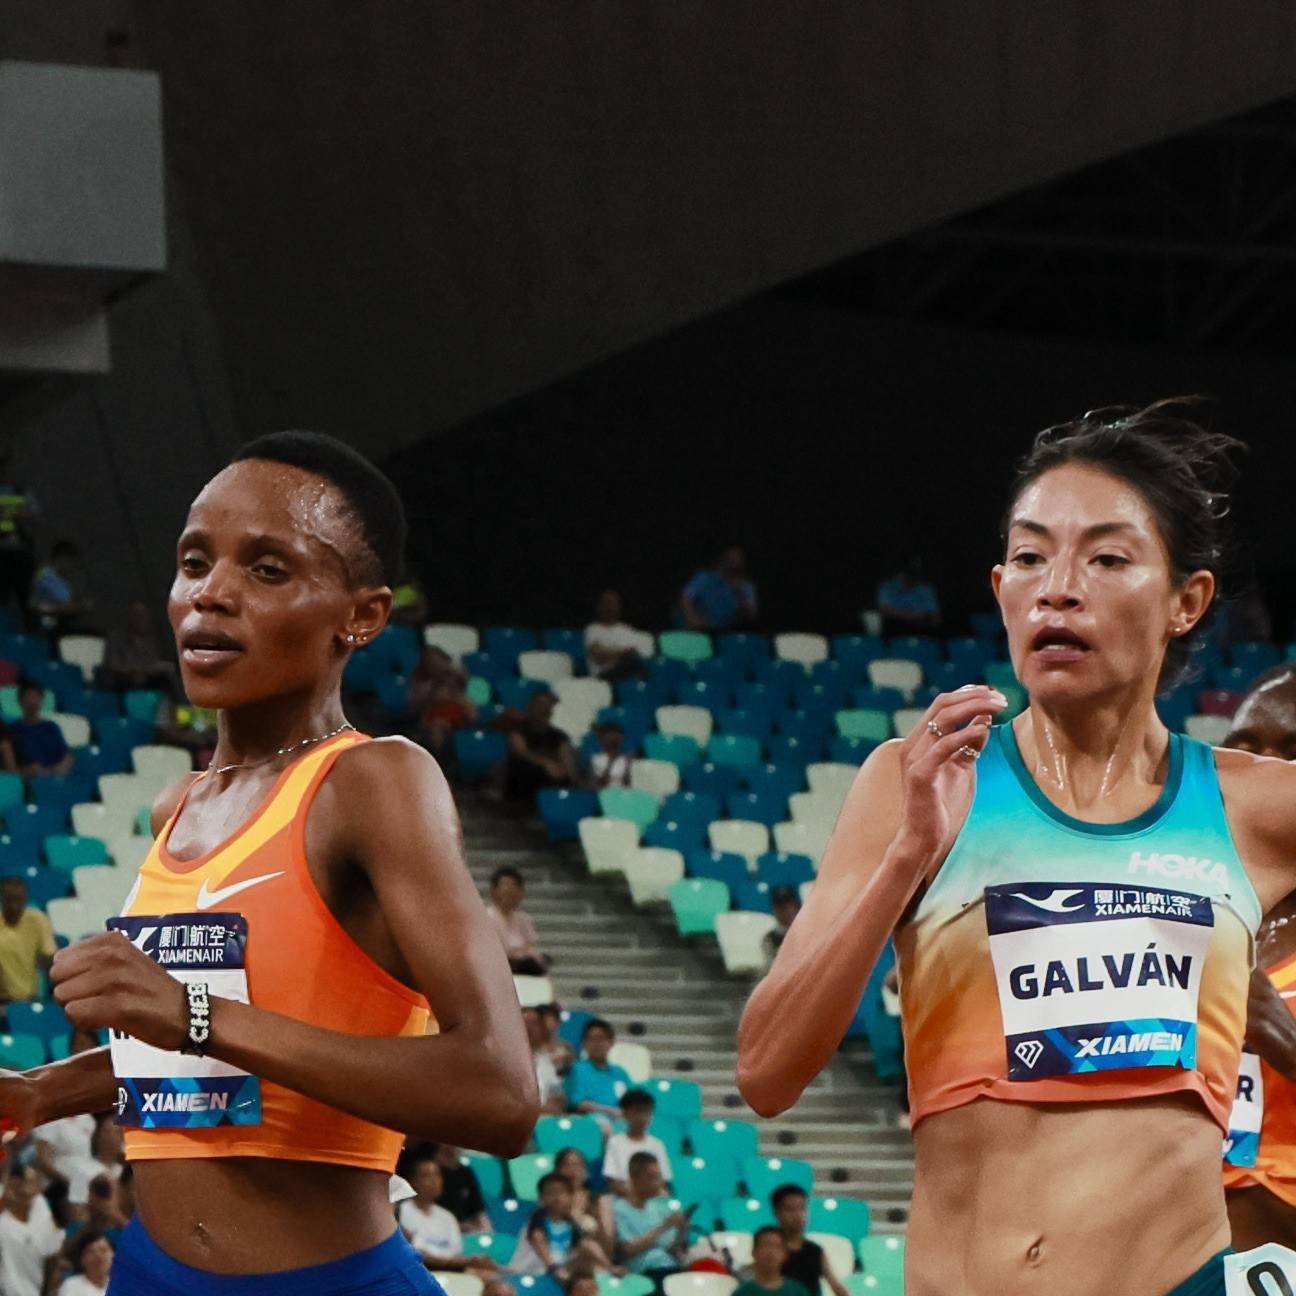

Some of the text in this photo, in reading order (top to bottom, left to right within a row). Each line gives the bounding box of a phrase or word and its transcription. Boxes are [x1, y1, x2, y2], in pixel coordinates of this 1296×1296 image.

[1128, 852, 1232, 888] HOKA
[1094, 889, 1192, 907] 厦门航空
[1095, 903, 1193, 918] XIAMENAIR
[158, 924, 226, 948] 厦门航空
[157, 948, 224, 964] XIAMENAIR
[1009, 942, 1193, 1001] GALVÁN
[1074, 1031, 1184, 1059] XIAMEN
[141, 1092, 229, 1113] XIAMEN
